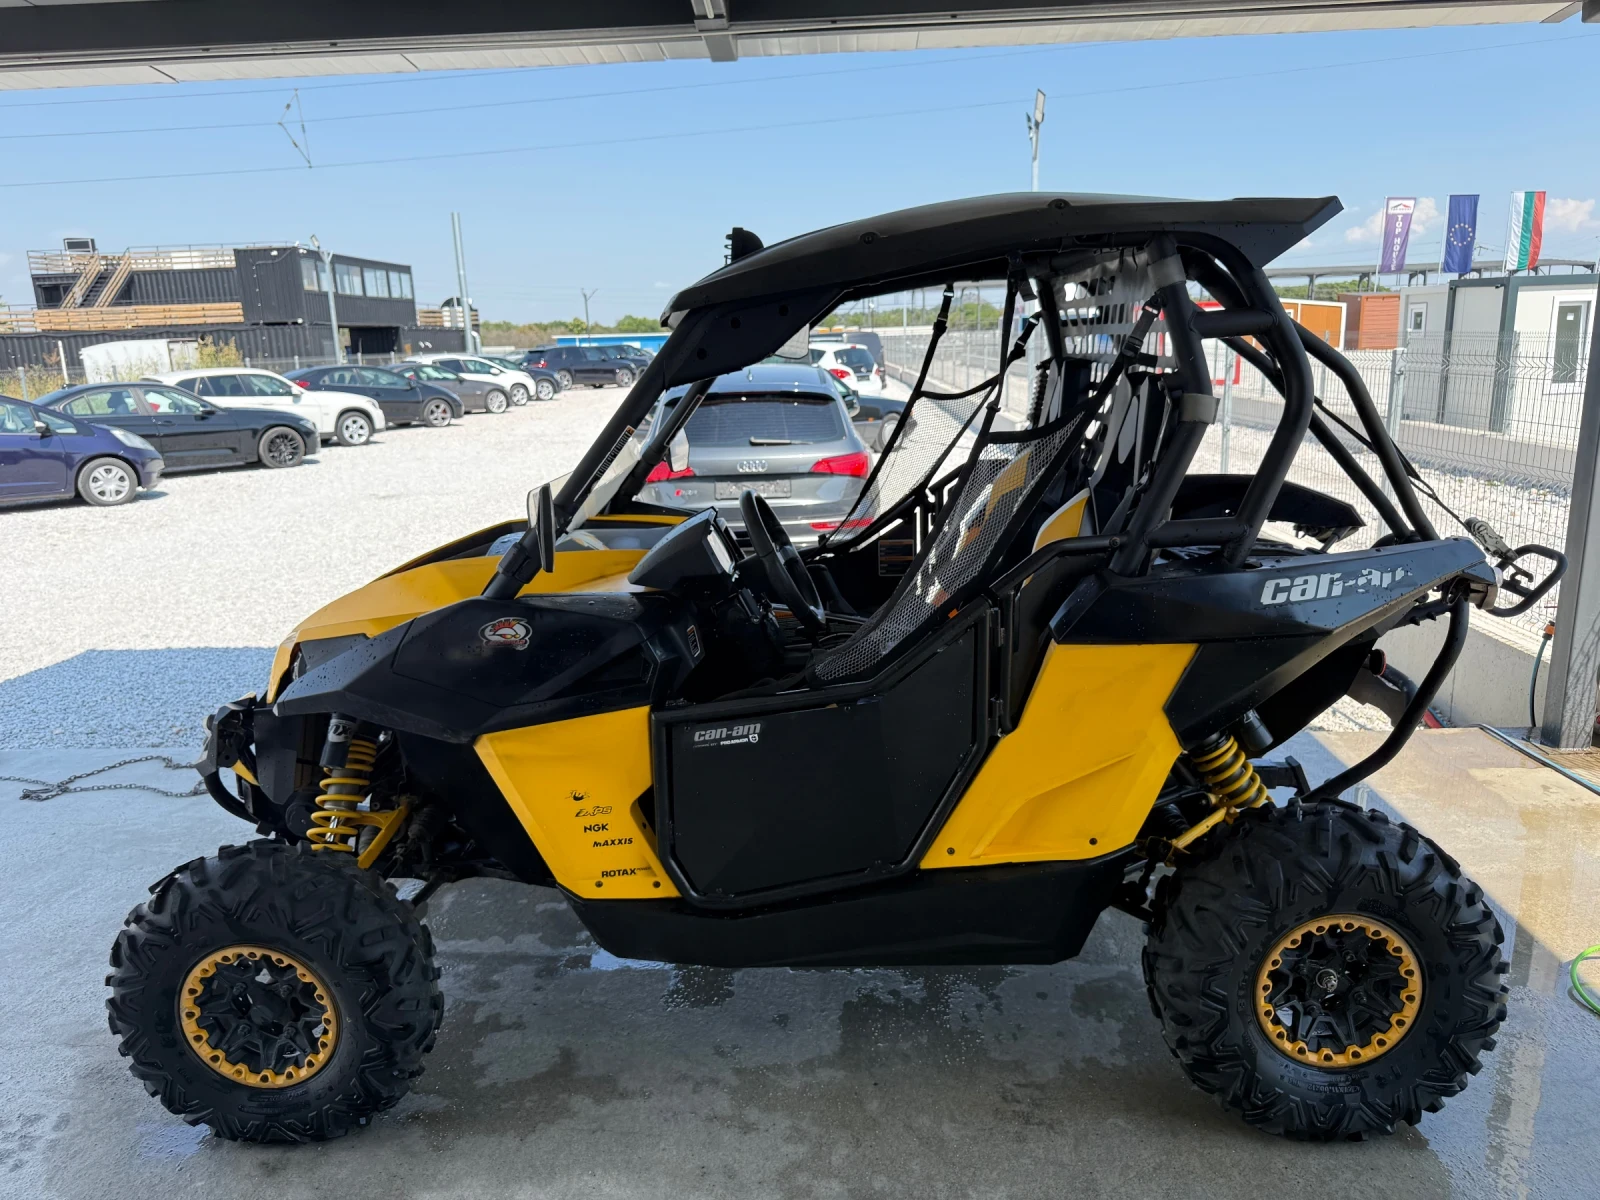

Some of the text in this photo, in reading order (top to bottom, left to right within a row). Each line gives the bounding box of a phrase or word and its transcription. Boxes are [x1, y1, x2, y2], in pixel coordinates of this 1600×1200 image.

[1391, 238, 1400, 270] HOUSE
[694, 723, 761, 741] can-am
[583, 822, 609, 833] NGK
[601, 867, 637, 878] ROTAX
